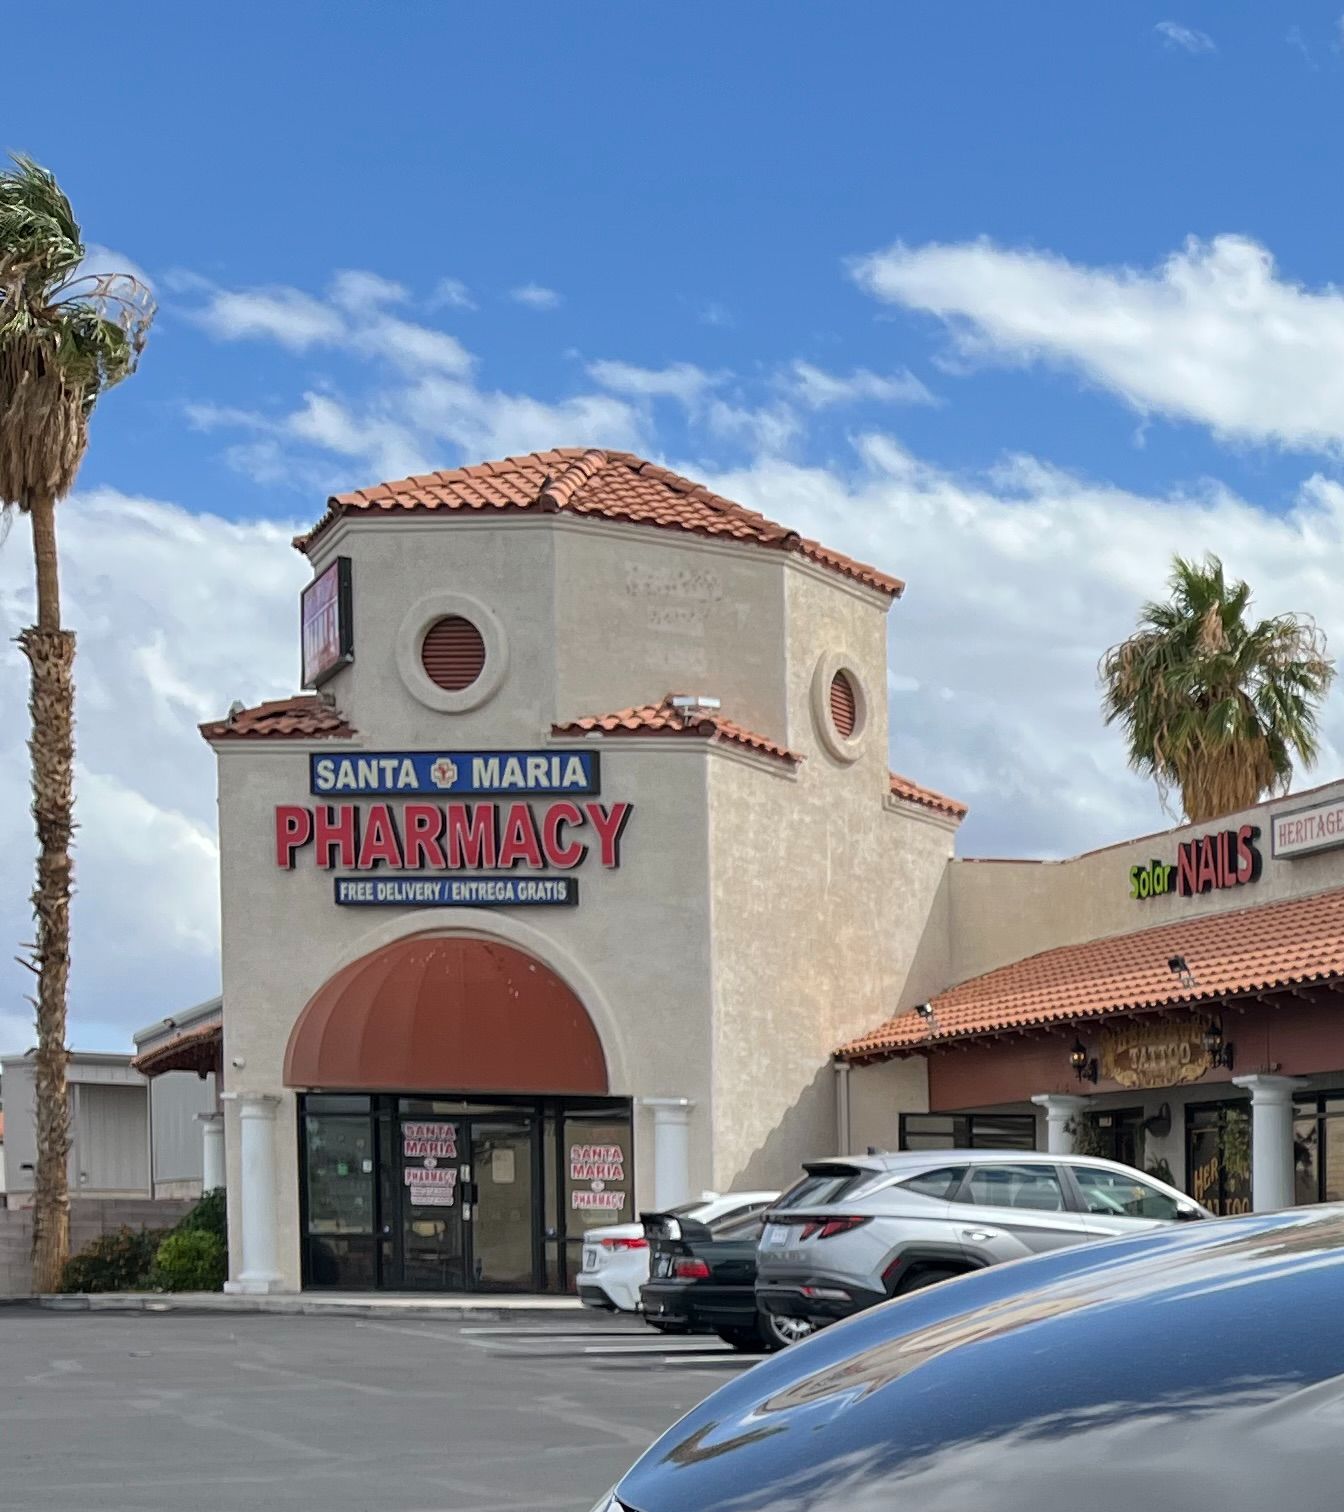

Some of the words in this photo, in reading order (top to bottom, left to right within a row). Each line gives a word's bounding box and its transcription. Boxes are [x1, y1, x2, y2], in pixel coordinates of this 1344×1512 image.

[316, 758, 418, 790] SANTA
[472, 757, 587, 788] MARIA
[274, 801, 631, 870] PHARMACY
[1278, 809, 1344, 848] HERITAGE
[1129, 859, 1174, 900] Solar
[1177, 824, 1258, 897] NAILS
[339, 881, 374, 900] FREE
[377, 881, 441, 900] DELIVERY
[452, 881, 515, 900] ENTREGA
[517, 881, 567, 900] GRATIS
[1128, 1042, 1191, 1071] TATTOO
[405, 1124, 455, 1139] SANTA
[405, 1141, 455, 1155] MARIA
[572, 1147, 623, 1161] SANTA
[572, 1163, 624, 1178] MARIA
